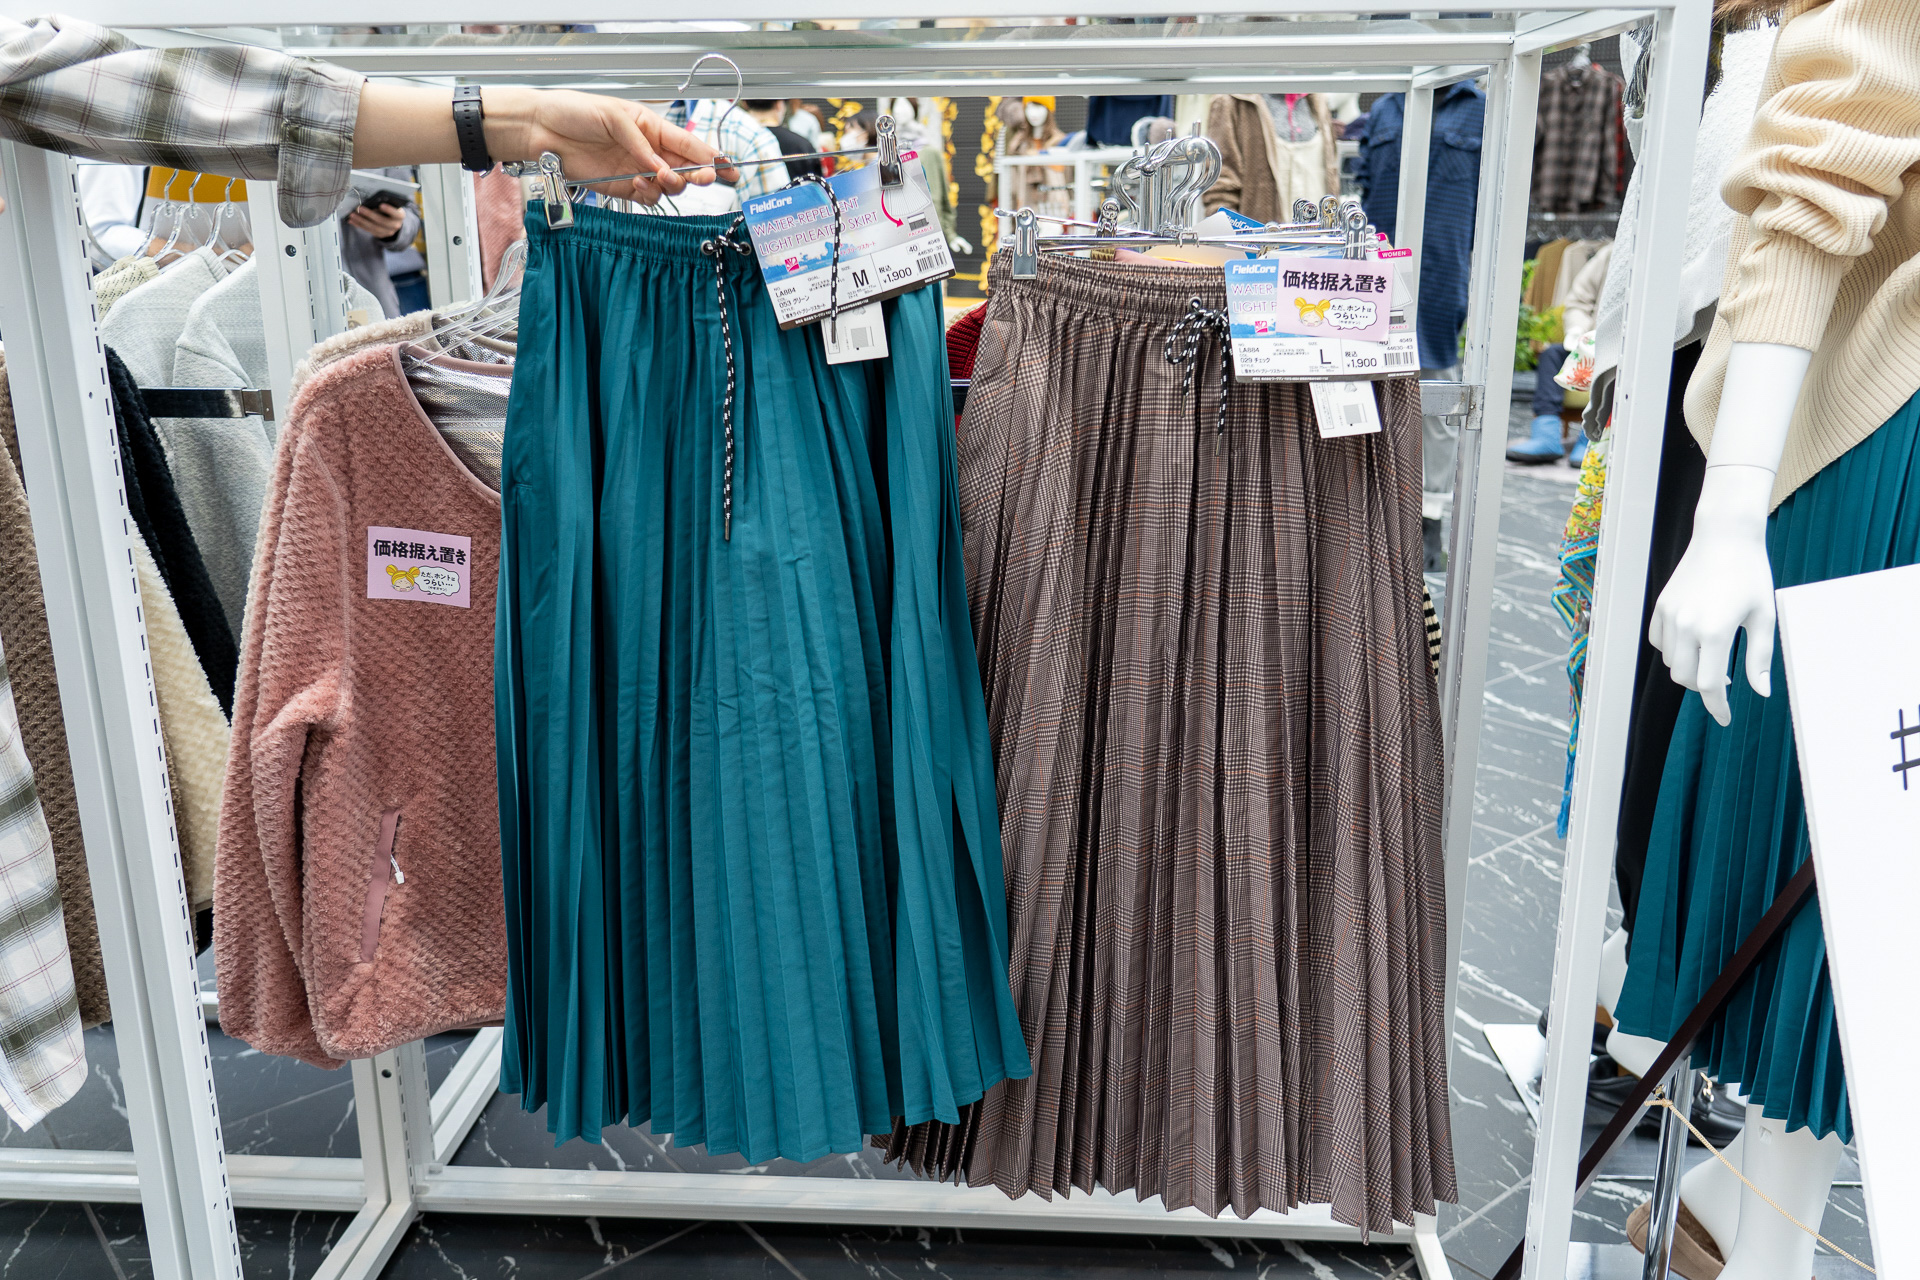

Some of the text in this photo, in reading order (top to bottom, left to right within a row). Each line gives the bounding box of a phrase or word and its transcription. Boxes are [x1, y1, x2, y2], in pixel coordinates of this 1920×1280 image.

[749, 196, 792, 215] FieldCore
[759, 236, 793, 257] LIGHT
[848, 211, 878, 231] SKIRT
[909, 245, 918, 253] 40
[1232, 264, 1277, 275] FieldCore
[851, 269, 869, 288] M
[1283, 270, 1387, 293] 価格据え置き
[775, 287, 796, 298] LA884
[1233, 301, 1267, 313] LIGHT
[1320, 349, 1332, 365] L
[373, 539, 467, 565] 価格据え置き
